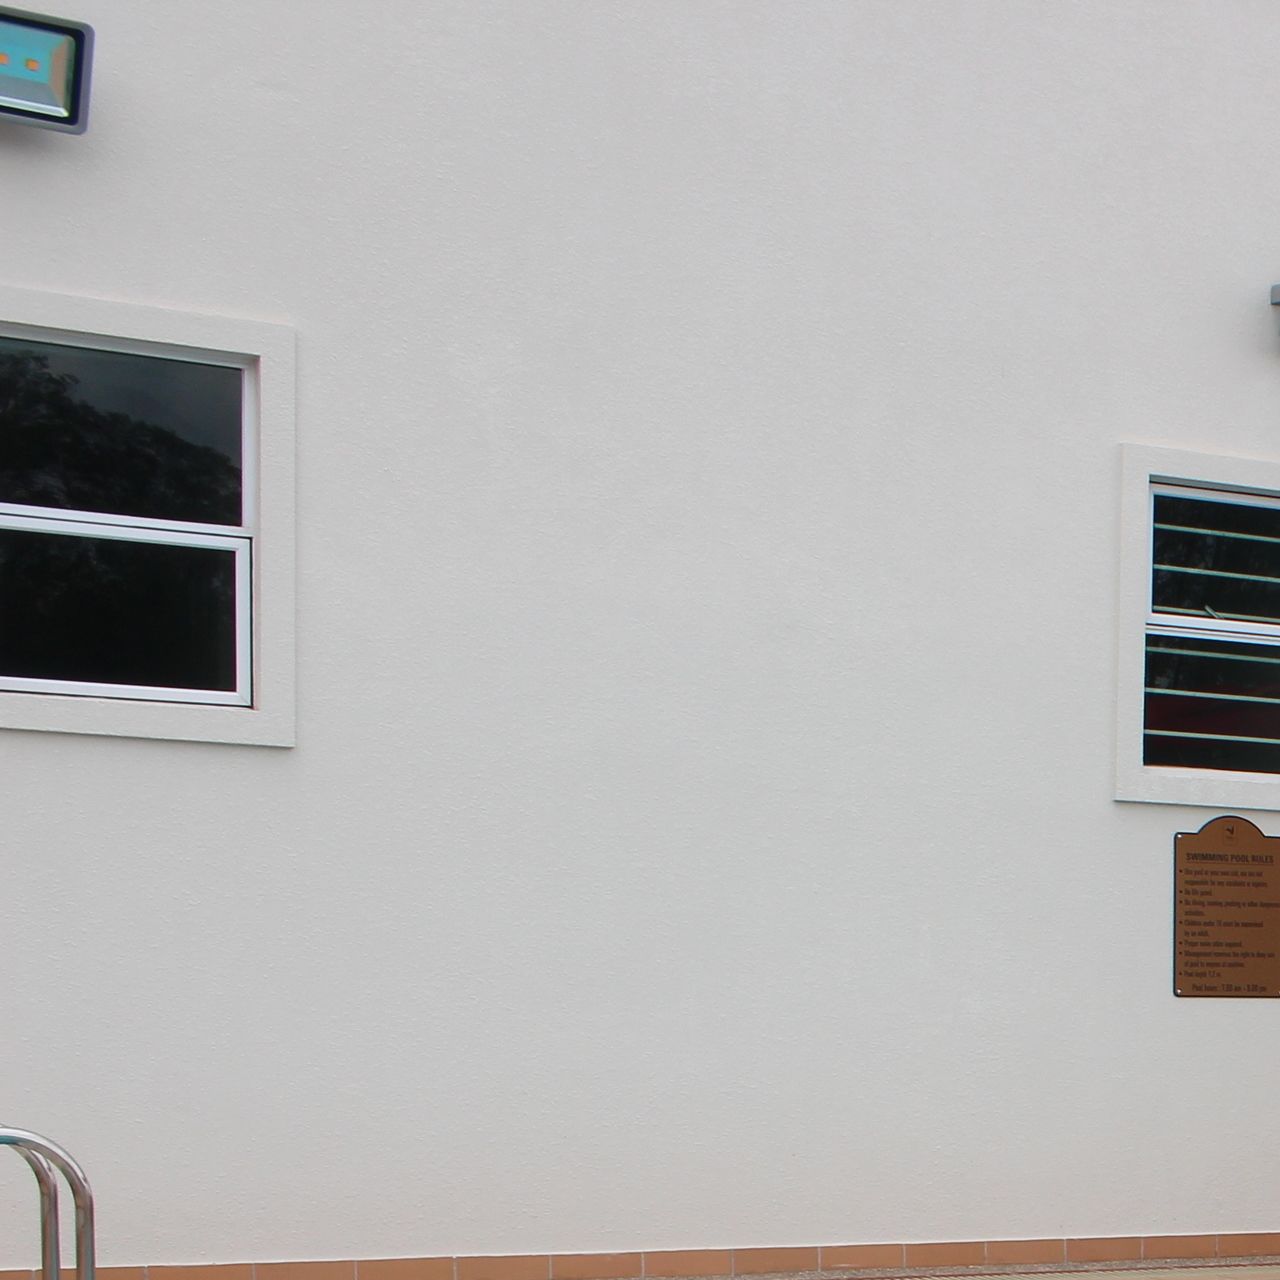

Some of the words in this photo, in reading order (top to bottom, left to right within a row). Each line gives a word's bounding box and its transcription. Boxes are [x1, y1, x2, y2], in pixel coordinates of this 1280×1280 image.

[1186, 852, 1229, 862] SWIMMING
[1230, 854, 1249, 863] POOL
[1251, 855, 1274, 864] RULES
